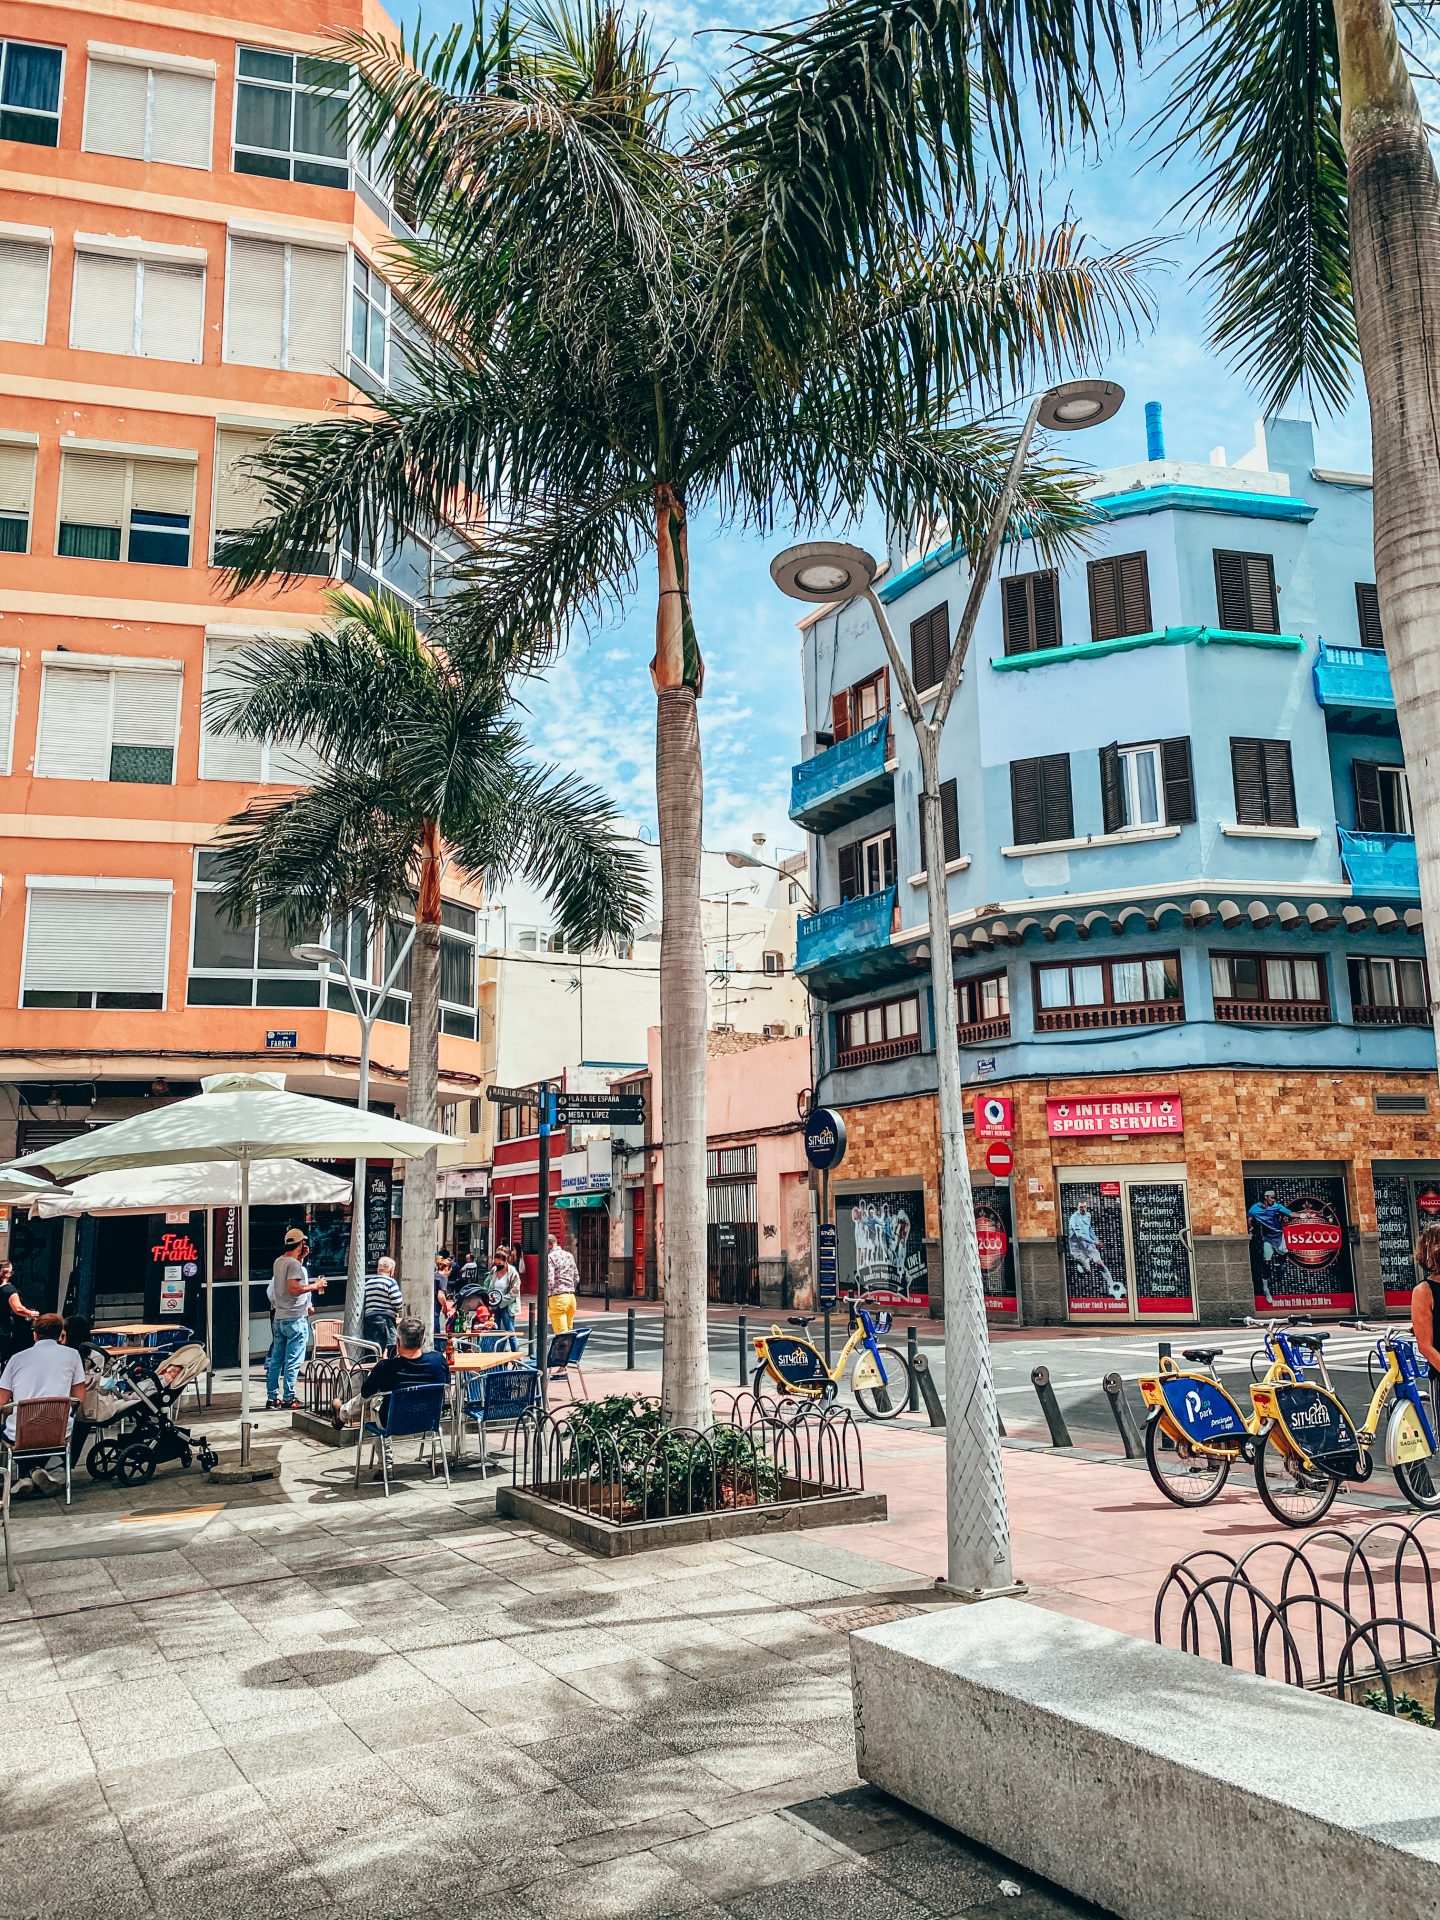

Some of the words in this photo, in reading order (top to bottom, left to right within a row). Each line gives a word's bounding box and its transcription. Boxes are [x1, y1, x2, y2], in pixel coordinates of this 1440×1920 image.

[568, 1095, 588, 1103] PLAZA
[588, 1095, 596, 1103] DE
[597, 1095, 620, 1103] ESPAÑA
[1075, 1101, 1153, 1116] INTERNET
[568, 1111, 585, 1119] MESA
[585, 1111, 591, 1119] Y
[1053, 1118, 1105, 1132] SPORT
[1109, 1115, 1178, 1130] SERVICE
[1148, 1193, 1177, 1204] Hockey
[1142, 1206, 1174, 1216] Ciclismo
[1377, 1221, 1402, 1233] osotros
[161, 1233, 190, 1251] Fat
[223, 1206, 236, 1267] Heineke
[1287, 1231, 1340, 1244] iss2000
[978, 1238, 1003, 1250] 2000
[151, 1243, 198, 1262] Frank
[1151, 1282, 1176, 1292] Boxeo
[1199, 1407, 1214, 1420] park
[1400, 1439, 1423, 1447] SAGULPA
